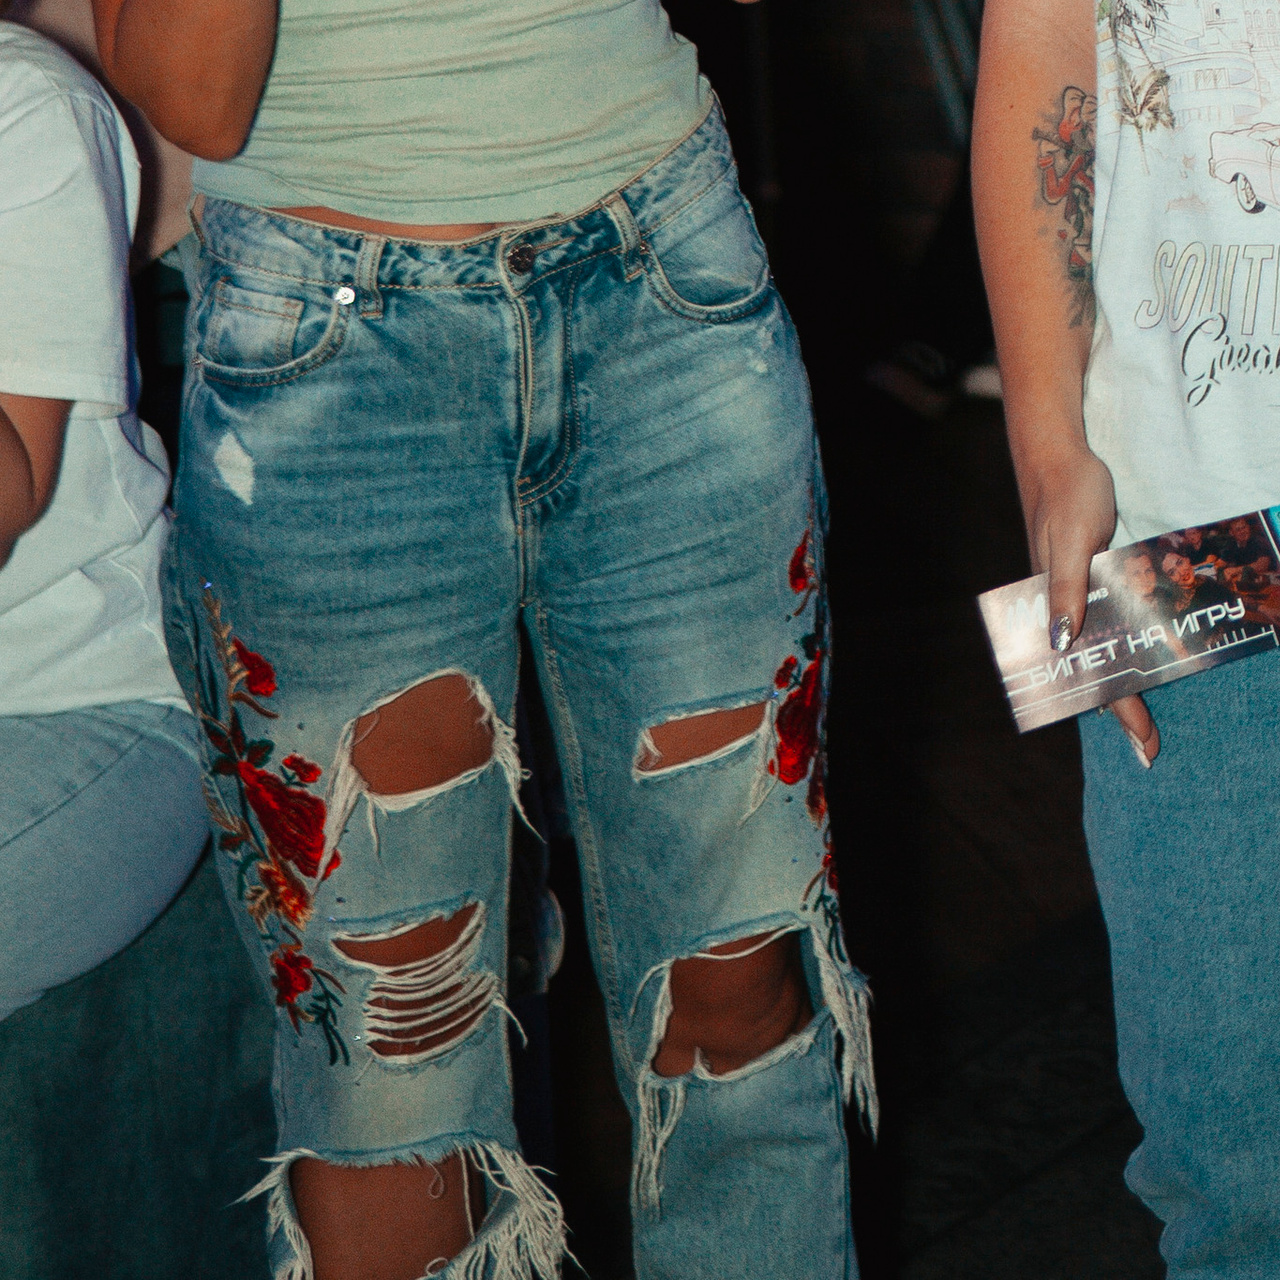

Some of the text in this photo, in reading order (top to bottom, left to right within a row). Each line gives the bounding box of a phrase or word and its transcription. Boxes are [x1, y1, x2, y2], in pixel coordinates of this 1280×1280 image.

[1027, 597, 1246, 686] БИЛЕТ НА ИГРУ
